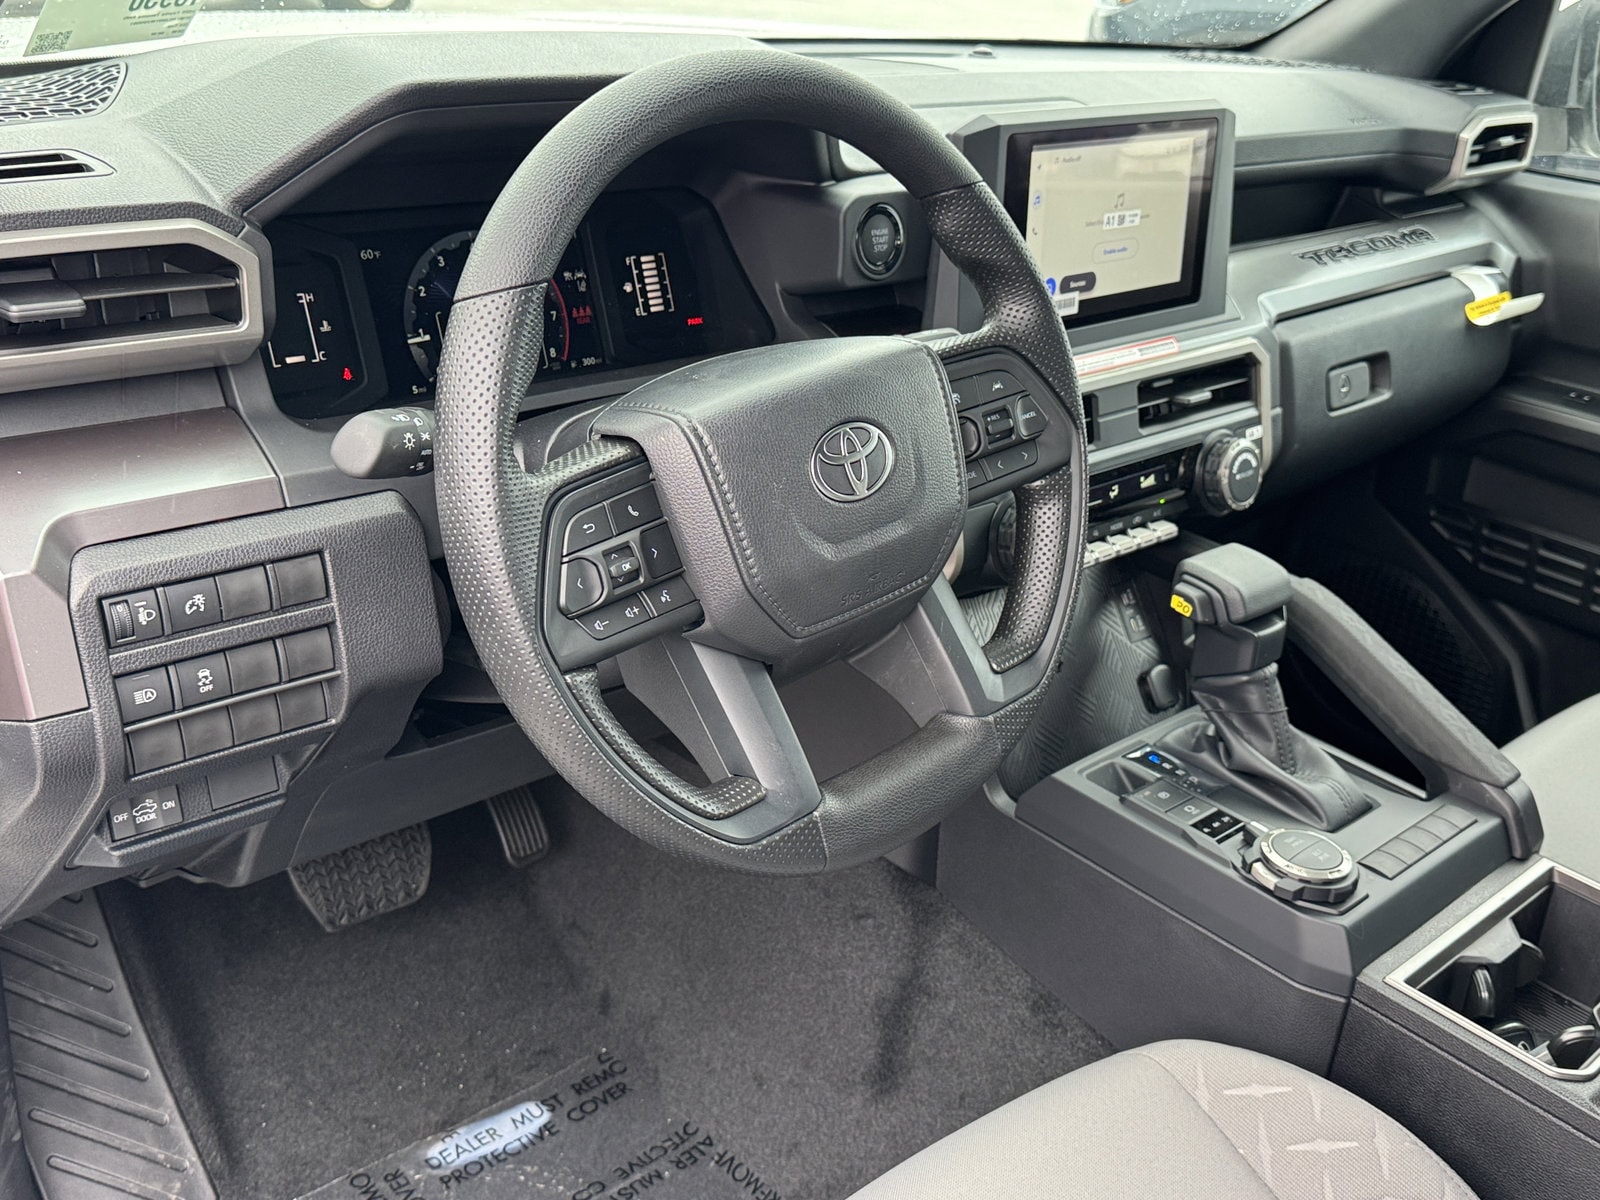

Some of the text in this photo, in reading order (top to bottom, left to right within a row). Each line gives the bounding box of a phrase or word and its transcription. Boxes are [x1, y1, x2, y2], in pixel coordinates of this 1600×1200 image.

[872, 236, 889, 244] START
[873, 244, 888, 252] STOP
[1298, 227, 1436, 265] TACOMA
[437, 256, 445, 267] 3
[418, 286, 427, 297] 2
[305, 293, 314, 302] H
[550, 311, 557, 321] 7
[549, 347, 557, 358] 8
[582, 357, 596, 367] 300
[621, 561, 632, 571] OK
[199, 684, 214, 694] OFF
[162, 800, 176, 810] ON
[113, 812, 129, 823] OFF
[135, 812, 157, 824] DOOR
[424, 1127, 503, 1171] DEALER
[510, 1092, 564, 1129] MUST
[439, 1082, 633, 1190] PROTECTIVE COVER
